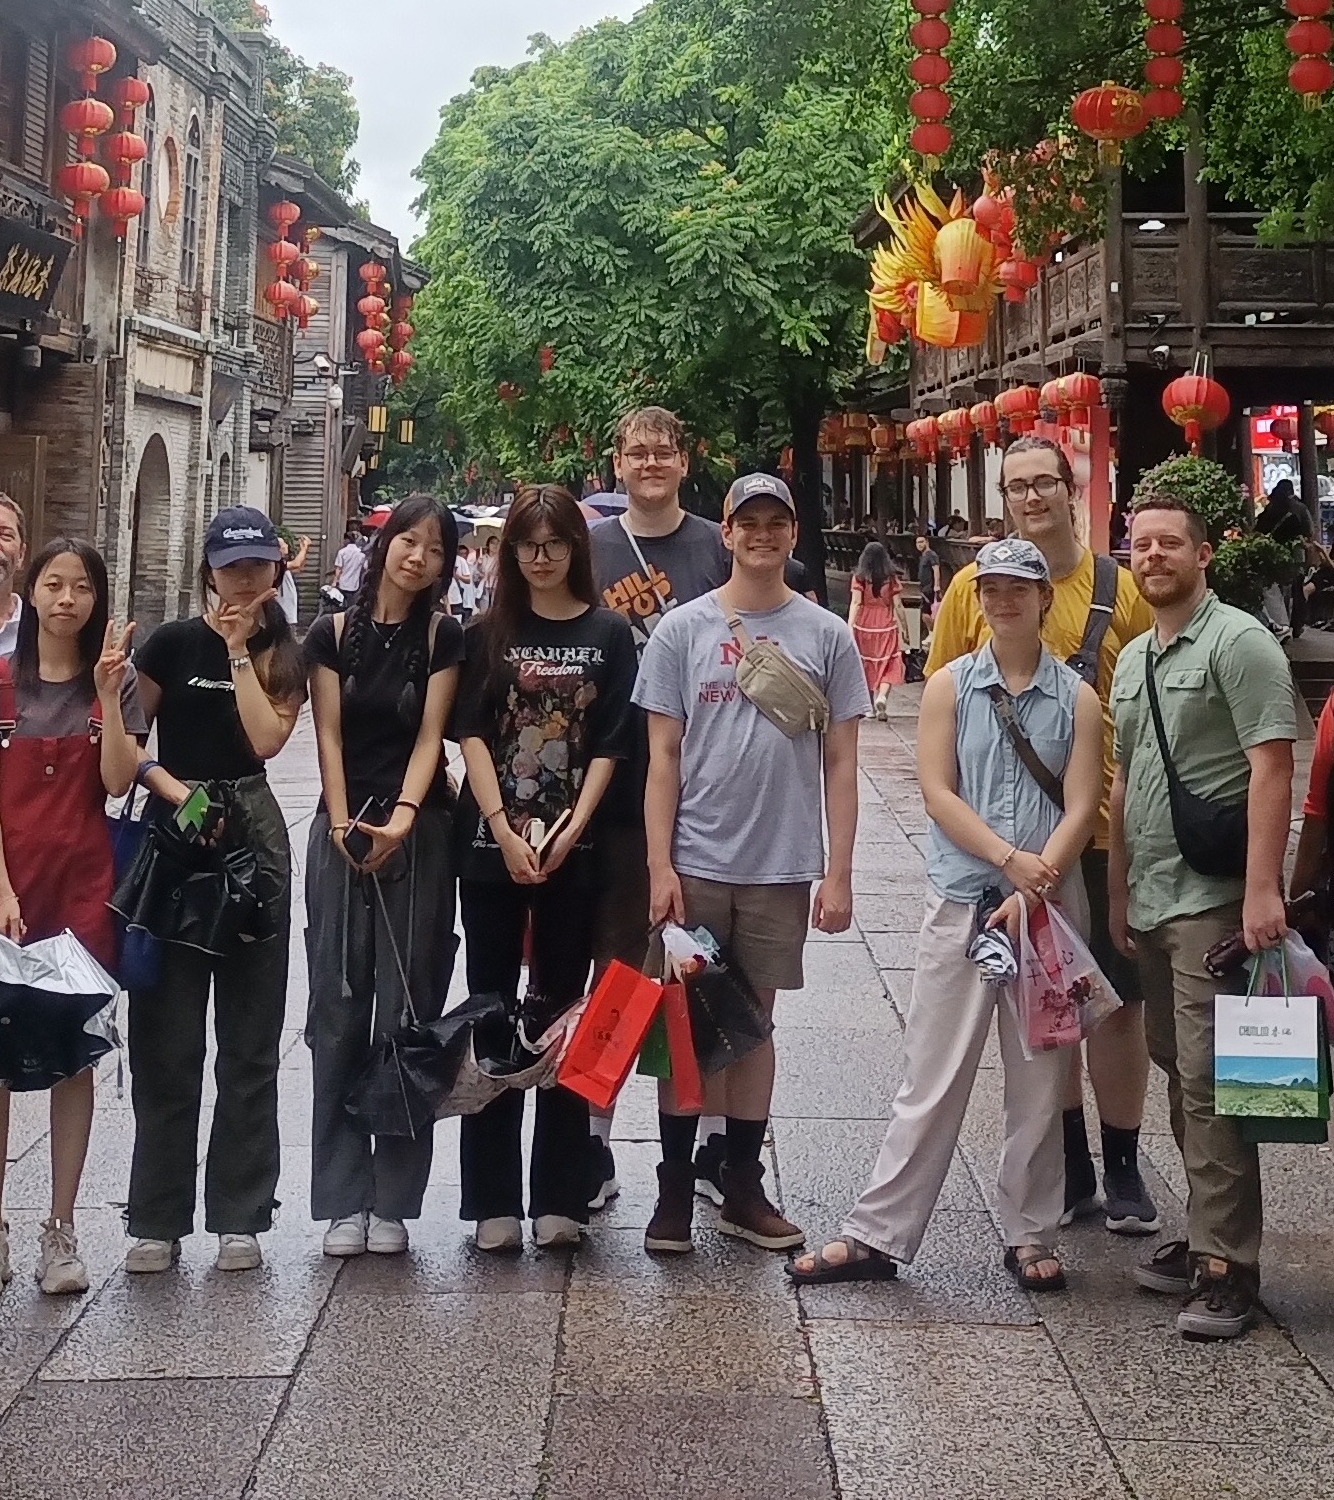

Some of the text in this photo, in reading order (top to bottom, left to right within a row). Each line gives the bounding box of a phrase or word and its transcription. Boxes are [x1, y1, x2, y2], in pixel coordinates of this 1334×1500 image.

[603, 563, 666, 610] HILL
[520, 660, 584, 676] Freedom
[700, 681, 738, 689] THE UN
[698, 690, 736, 703] NEW
